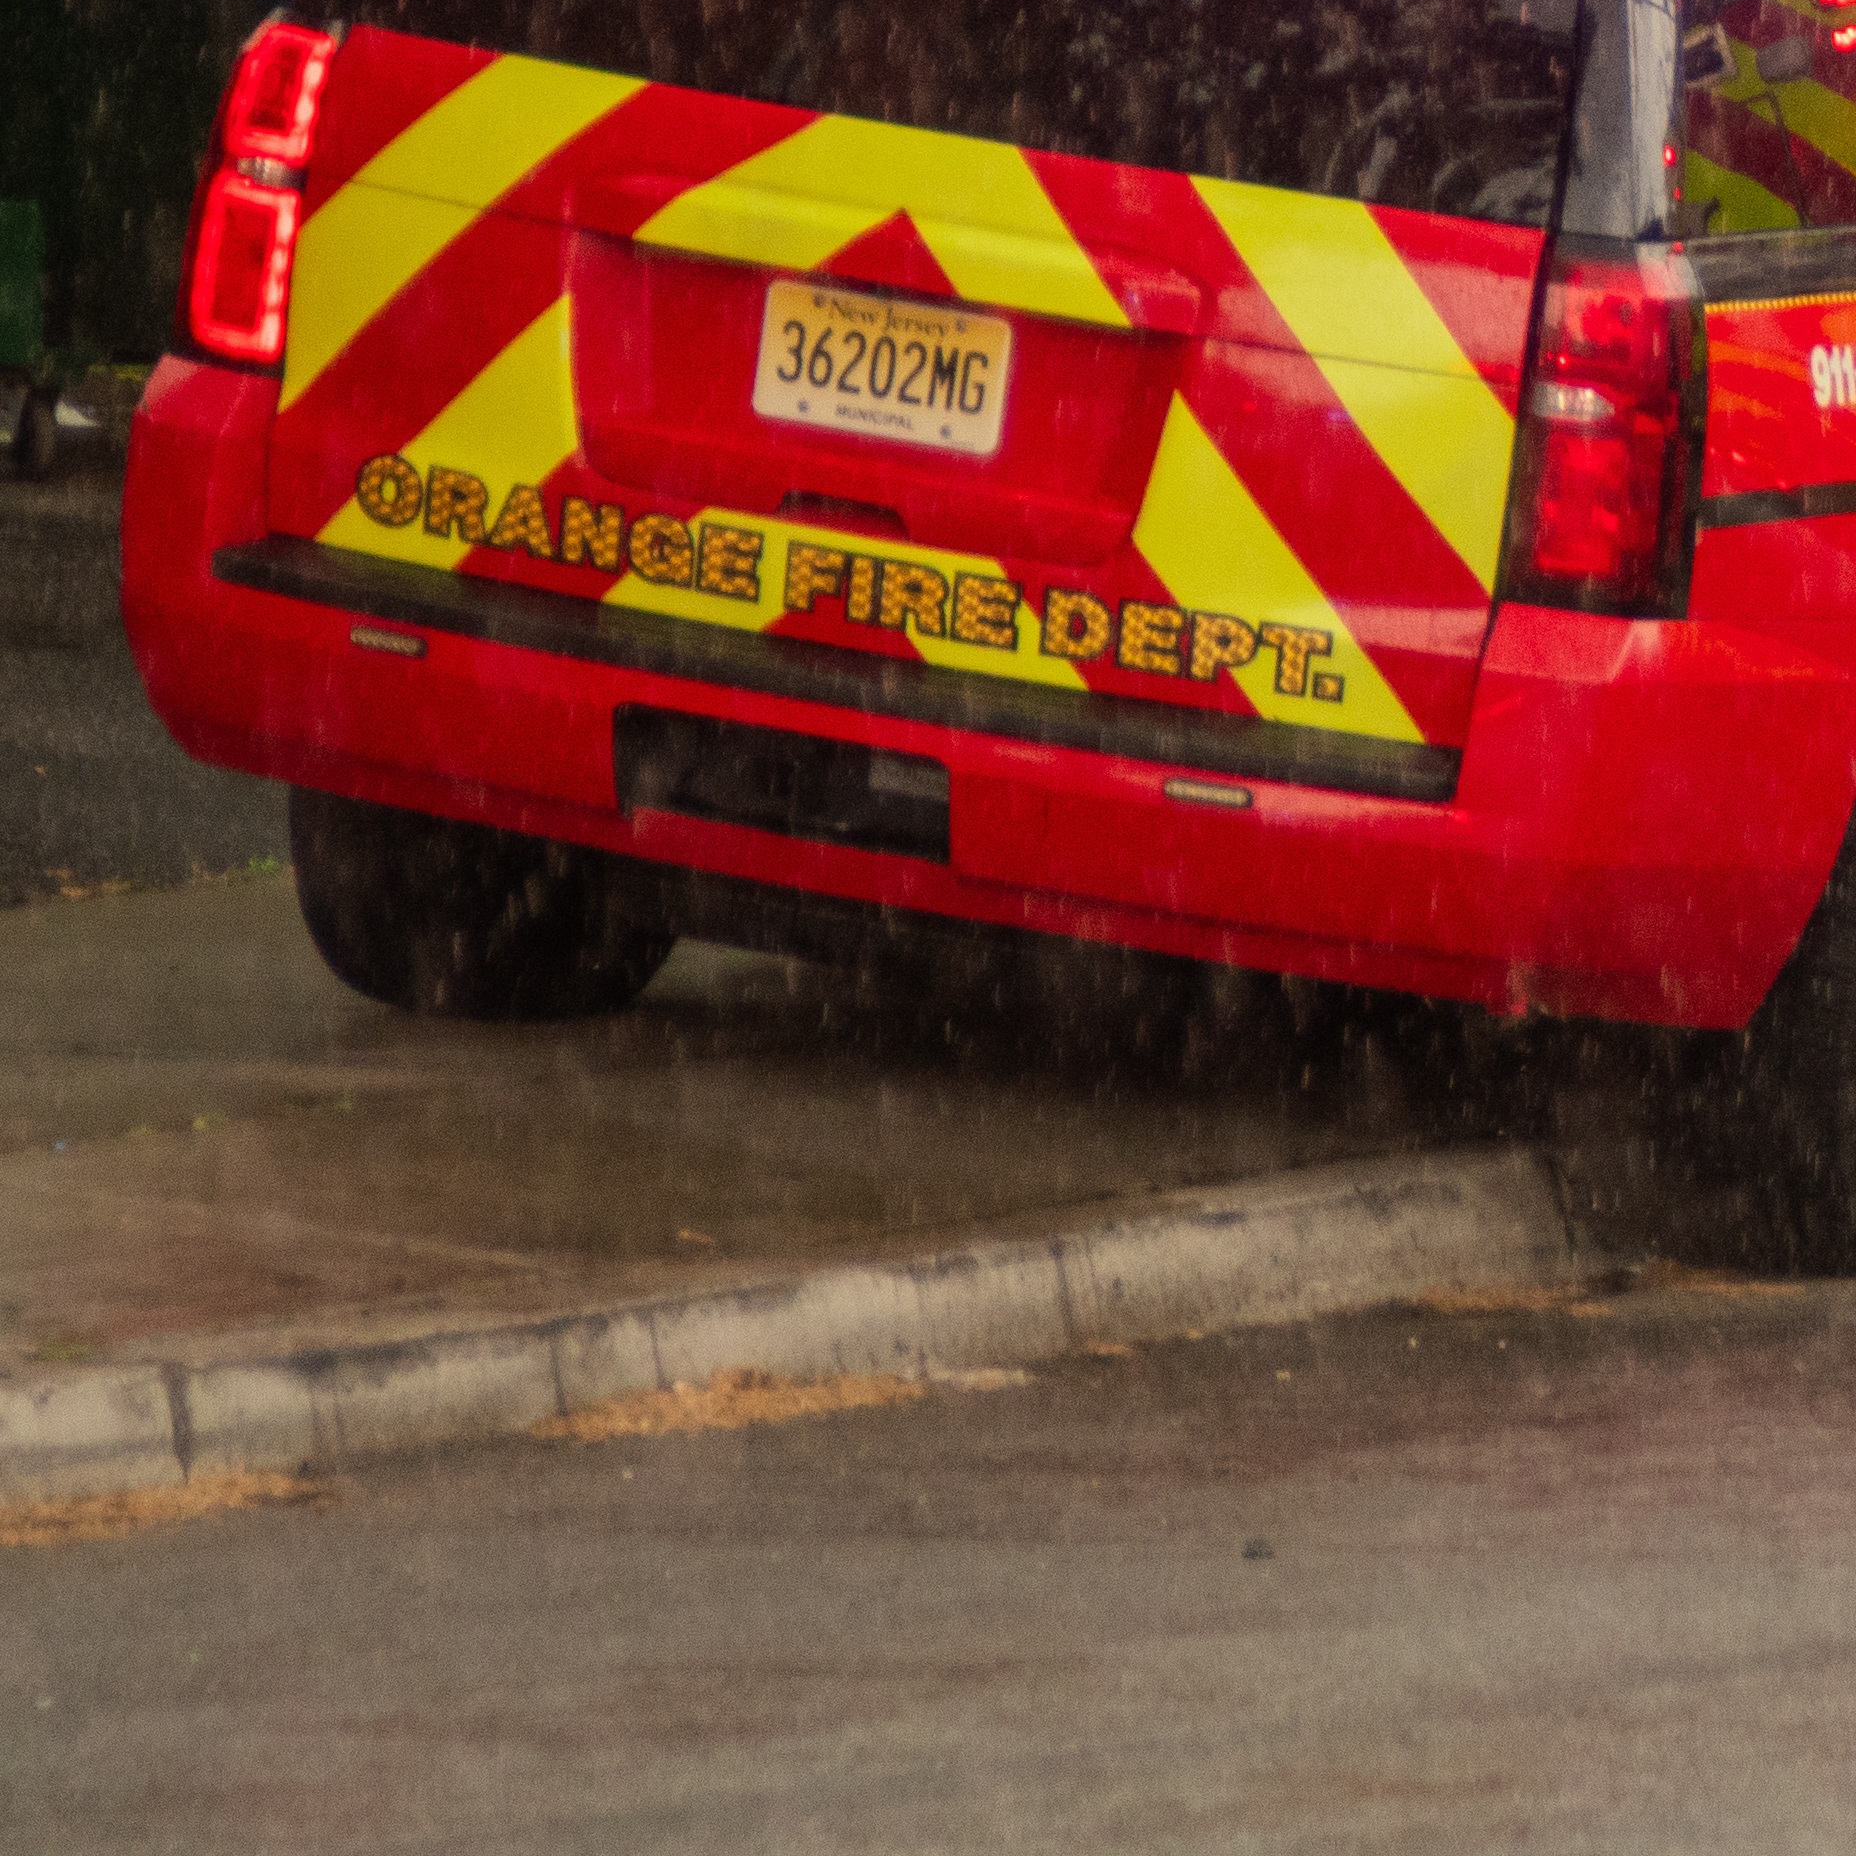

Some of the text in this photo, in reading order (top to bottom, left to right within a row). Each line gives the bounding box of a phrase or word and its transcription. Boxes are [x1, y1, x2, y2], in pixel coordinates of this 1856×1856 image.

[829, 297, 948, 337] New Jersey
[775, 318, 990, 416] 36202MG
[835, 403, 915, 431] MUNICIPAL
[355, 452, 1346, 705] ORANGE FIRE DEPT.
